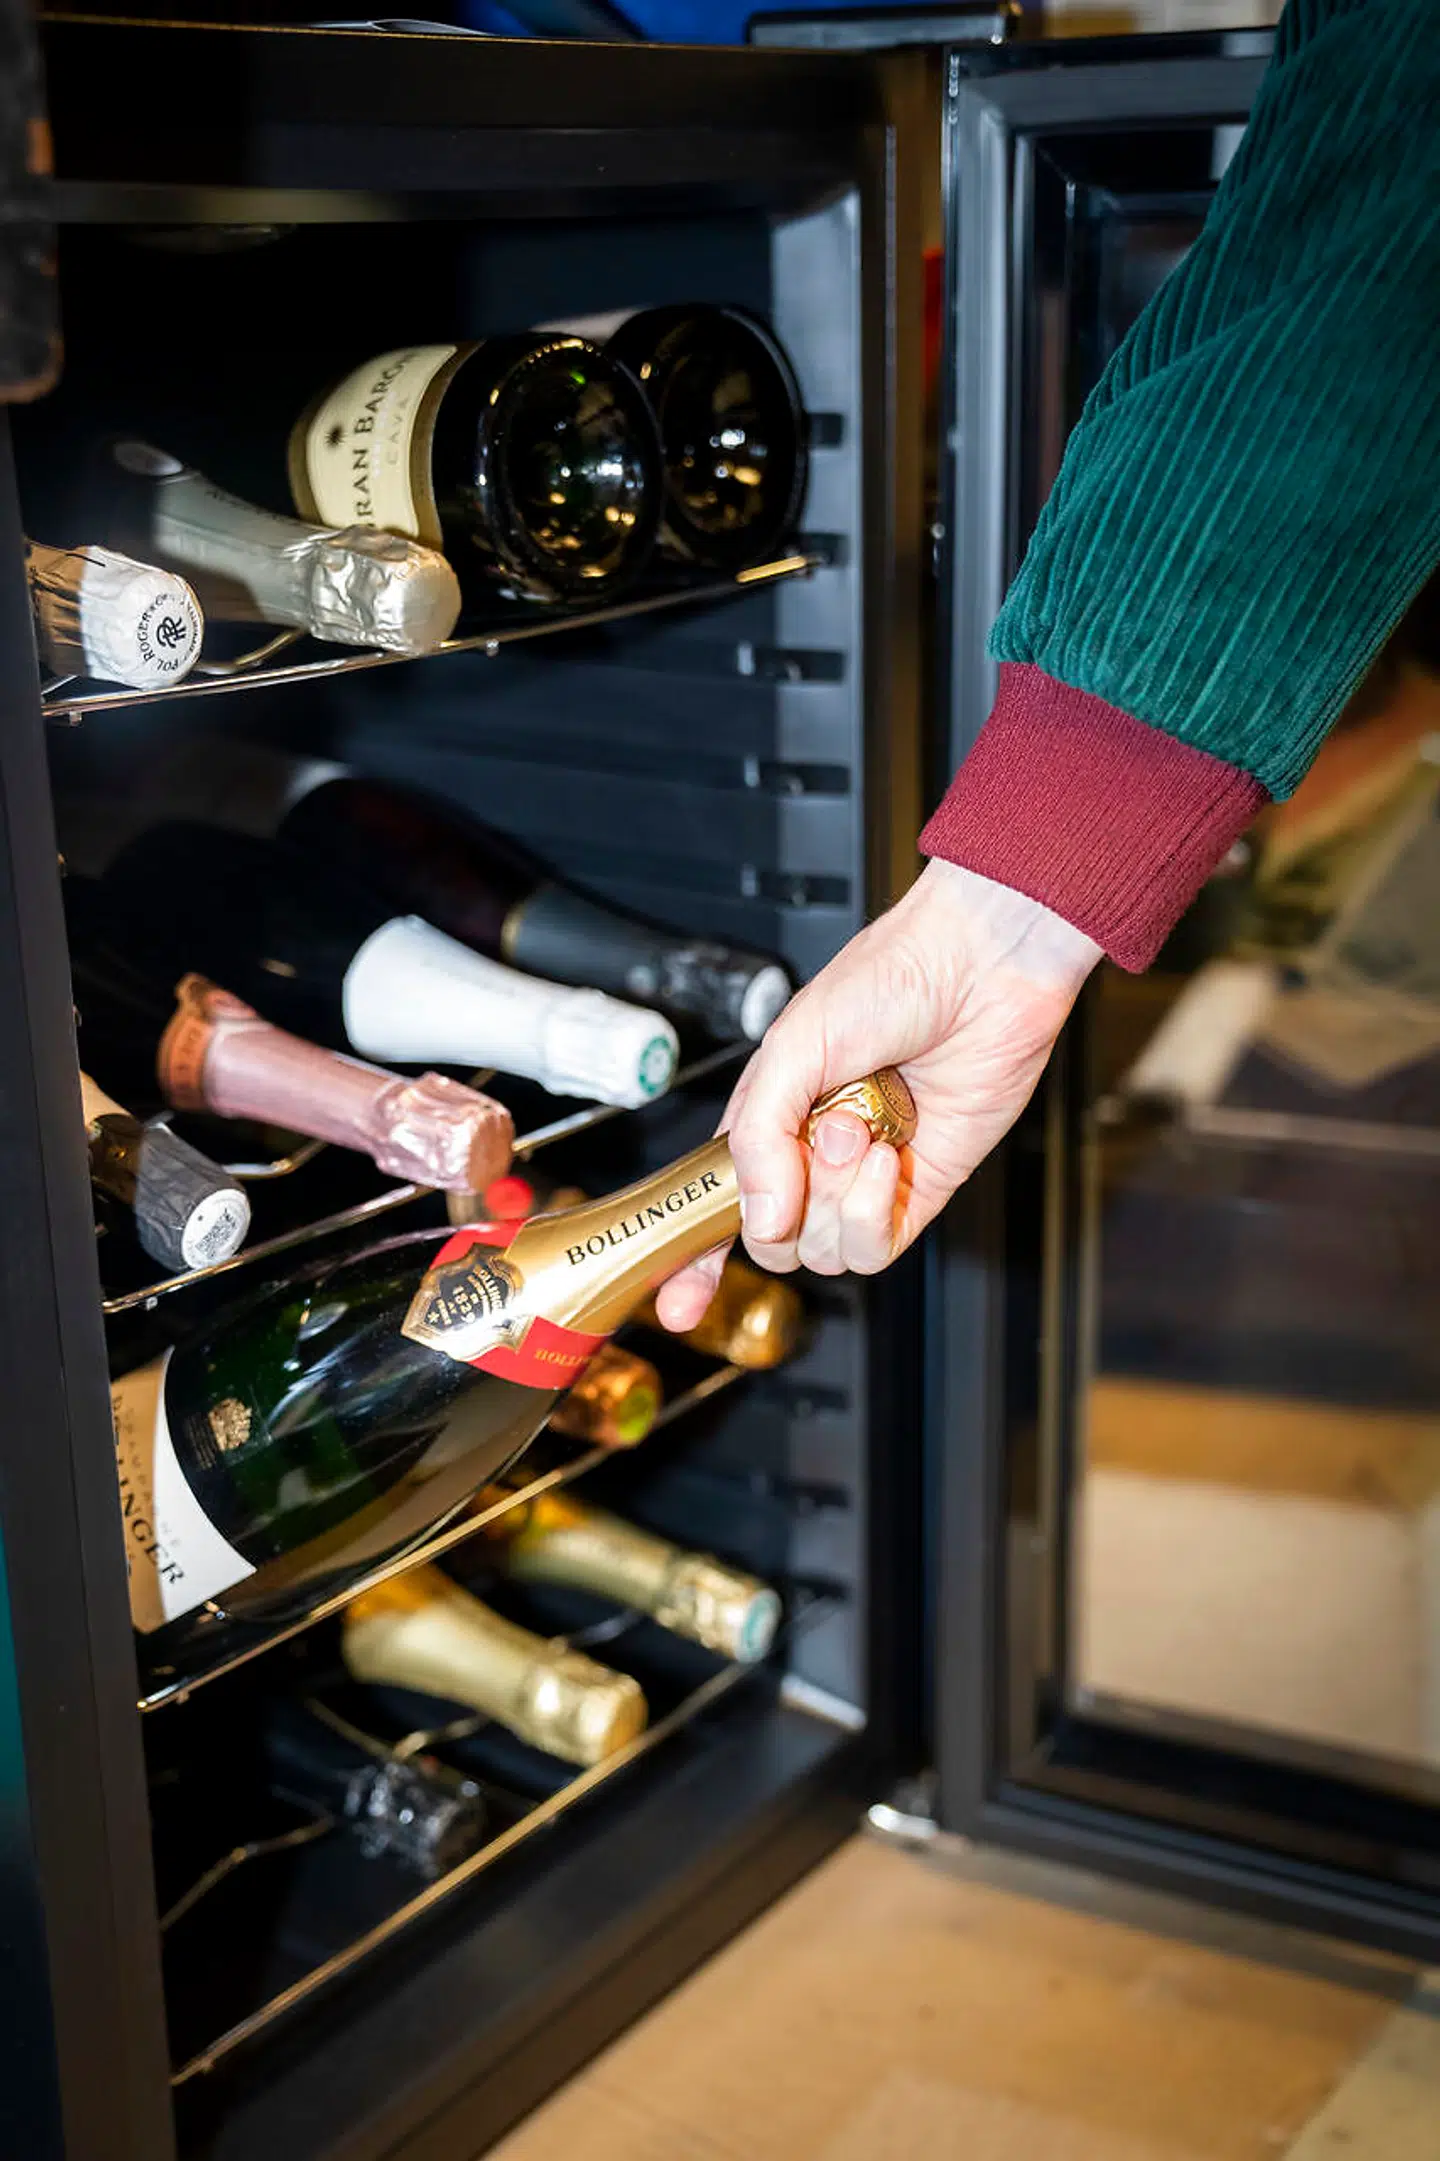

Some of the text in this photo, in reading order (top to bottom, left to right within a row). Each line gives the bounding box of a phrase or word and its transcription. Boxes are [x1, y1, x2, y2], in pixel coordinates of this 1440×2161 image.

[353, 449, 375, 528] RAN
[136, 611, 156, 662] ROGER
[565, 1171, 722, 1266] BOLLINGER
[452, 1285, 476, 1324] 1829
